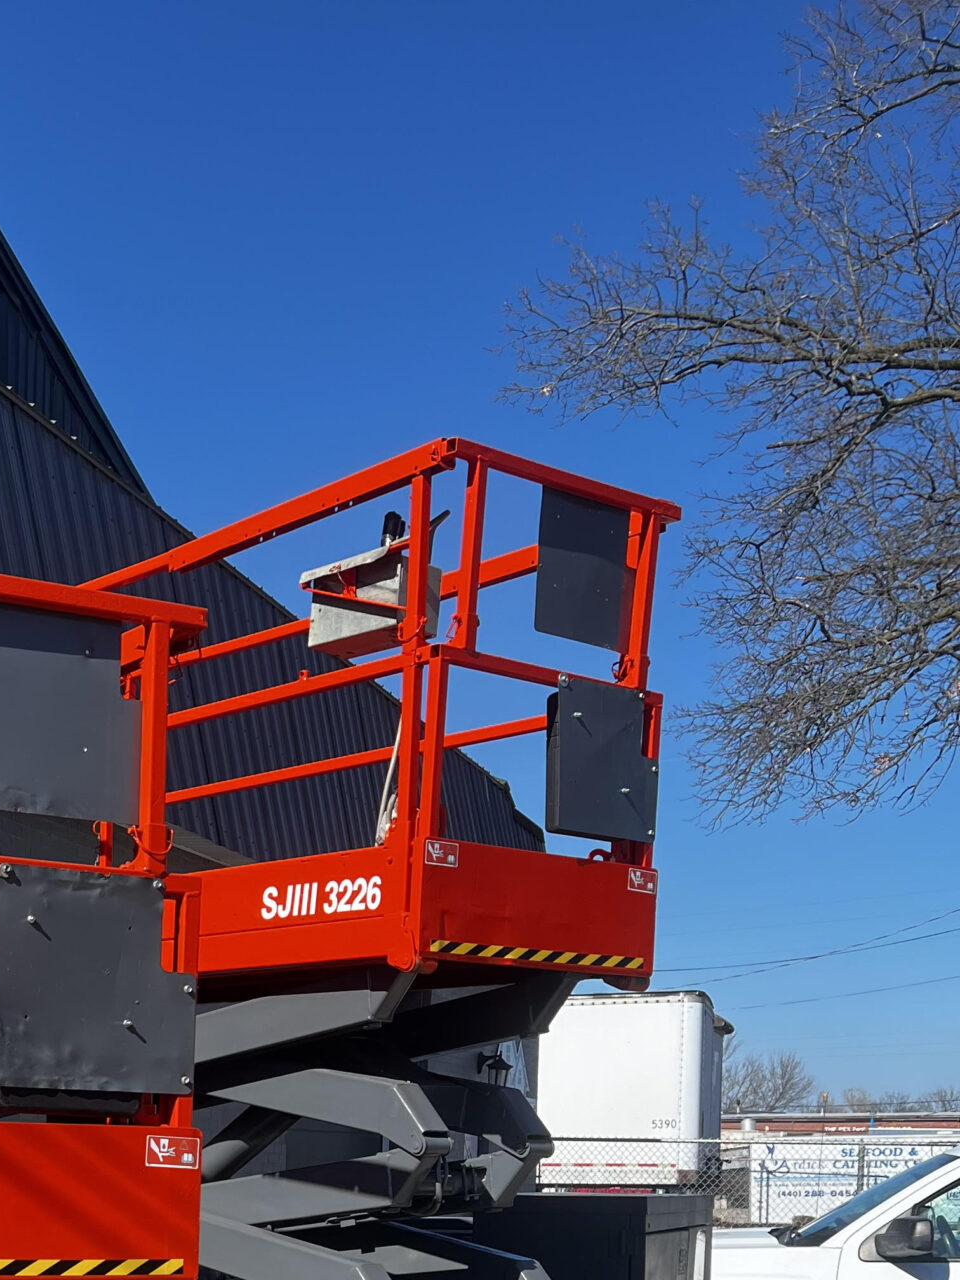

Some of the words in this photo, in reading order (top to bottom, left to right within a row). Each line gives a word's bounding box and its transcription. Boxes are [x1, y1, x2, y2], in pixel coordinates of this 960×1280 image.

[323, 875, 382, 914] 3226
[651, 1119, 677, 1129] 5390
[841, 1147, 903, 1157] SEFOOD
[908, 1147, 918, 1157] &
[833, 1160, 898, 1169] CATRING
